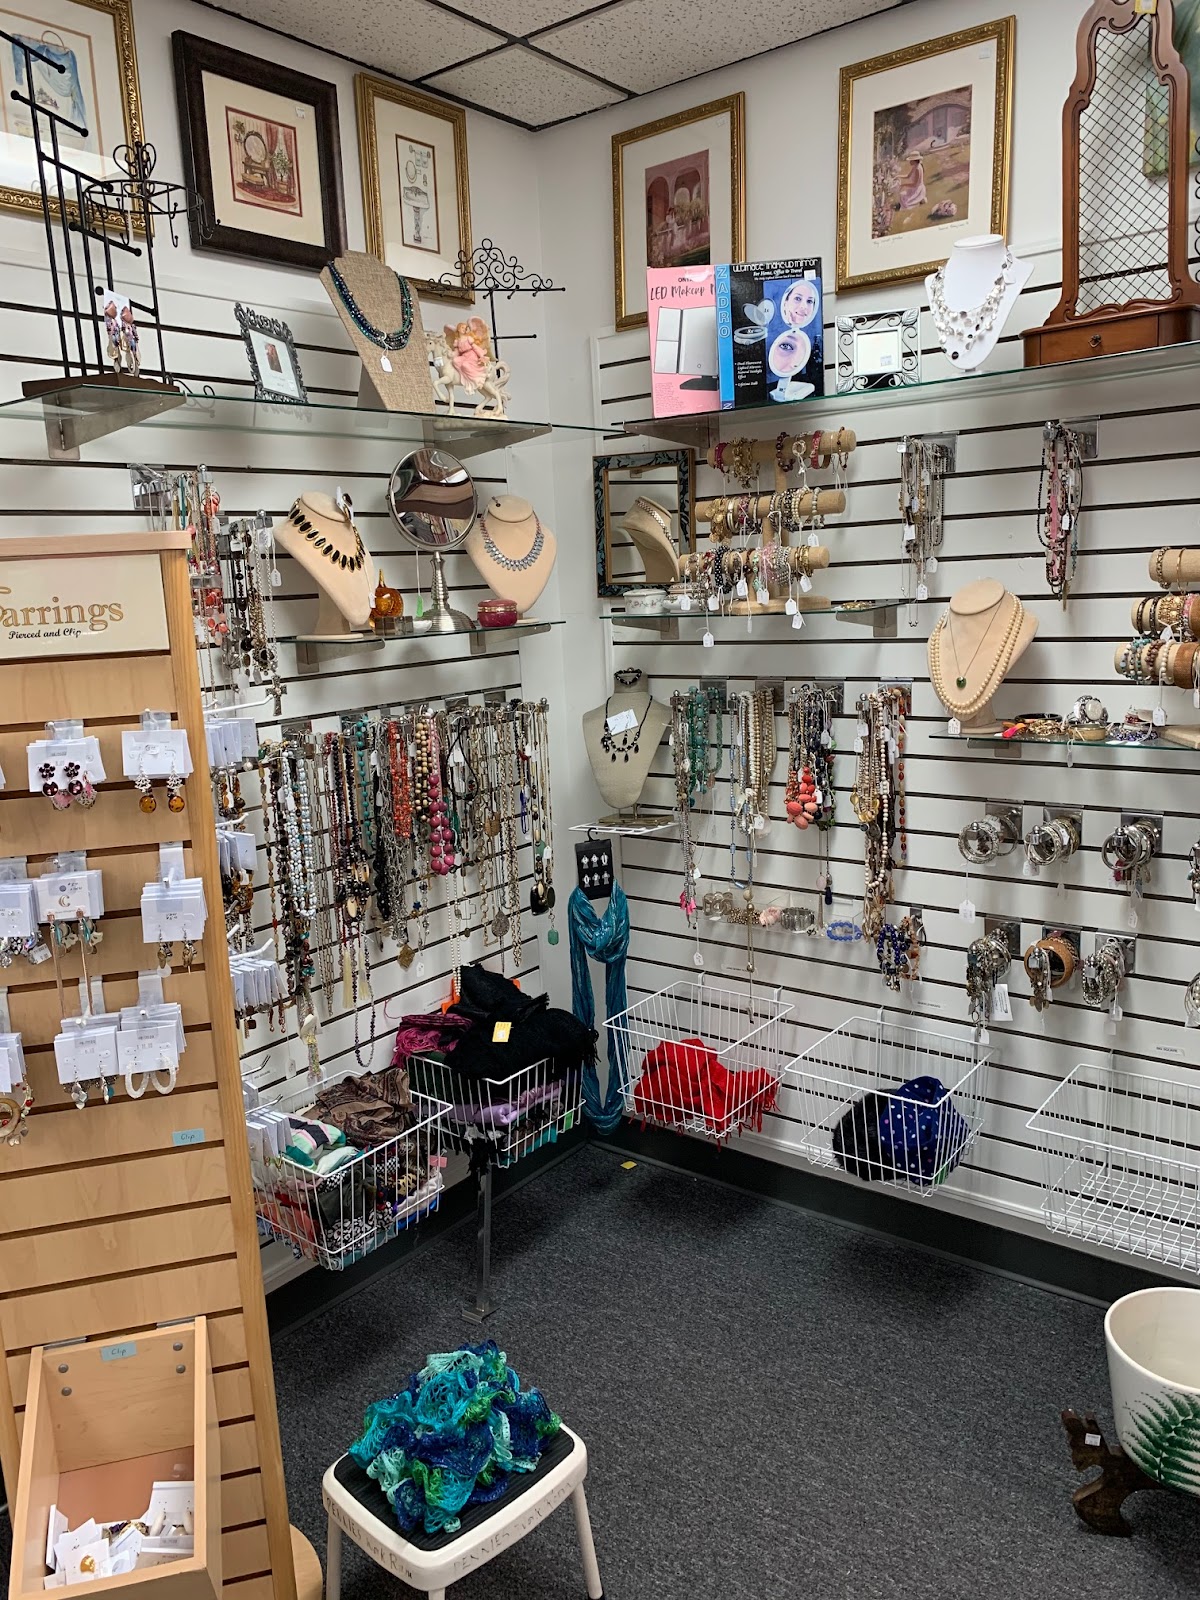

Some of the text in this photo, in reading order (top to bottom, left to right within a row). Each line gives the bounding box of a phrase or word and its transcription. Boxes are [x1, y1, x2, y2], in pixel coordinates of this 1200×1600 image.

[651, 286, 667, 300] LED
[671, 285, 704, 298] Makeup
[717, 266, 731, 338] ZADRO
[8, 627, 81, 640] Pierced and Clip
[181, 1132, 195, 1142] Clip
[111, 1347, 127, 1358] Clip
